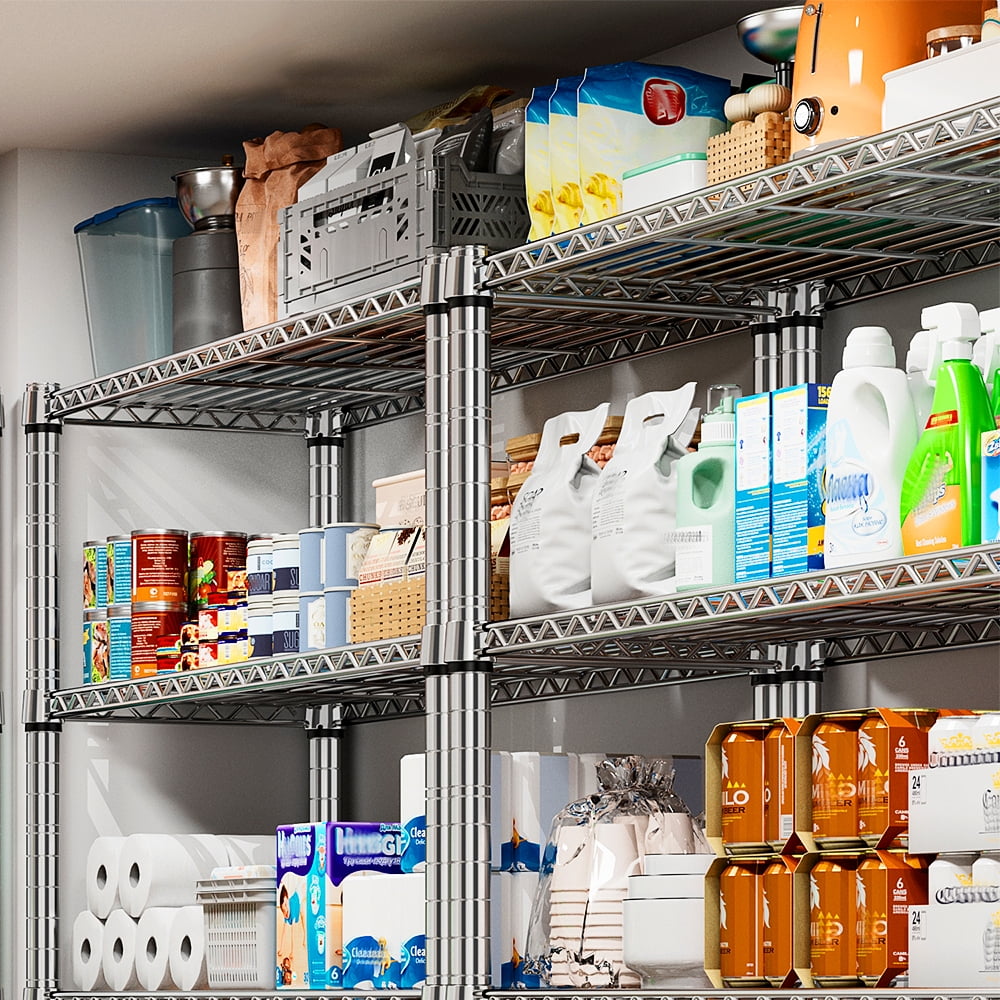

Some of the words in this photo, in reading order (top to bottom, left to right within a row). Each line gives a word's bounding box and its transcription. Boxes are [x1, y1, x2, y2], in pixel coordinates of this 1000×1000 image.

[898, 736, 906, 747] 6
[912, 776, 921, 789] 24
[896, 877, 905, 888] 6
[912, 911, 921, 925] 24
[330, 971, 339, 980] 6
